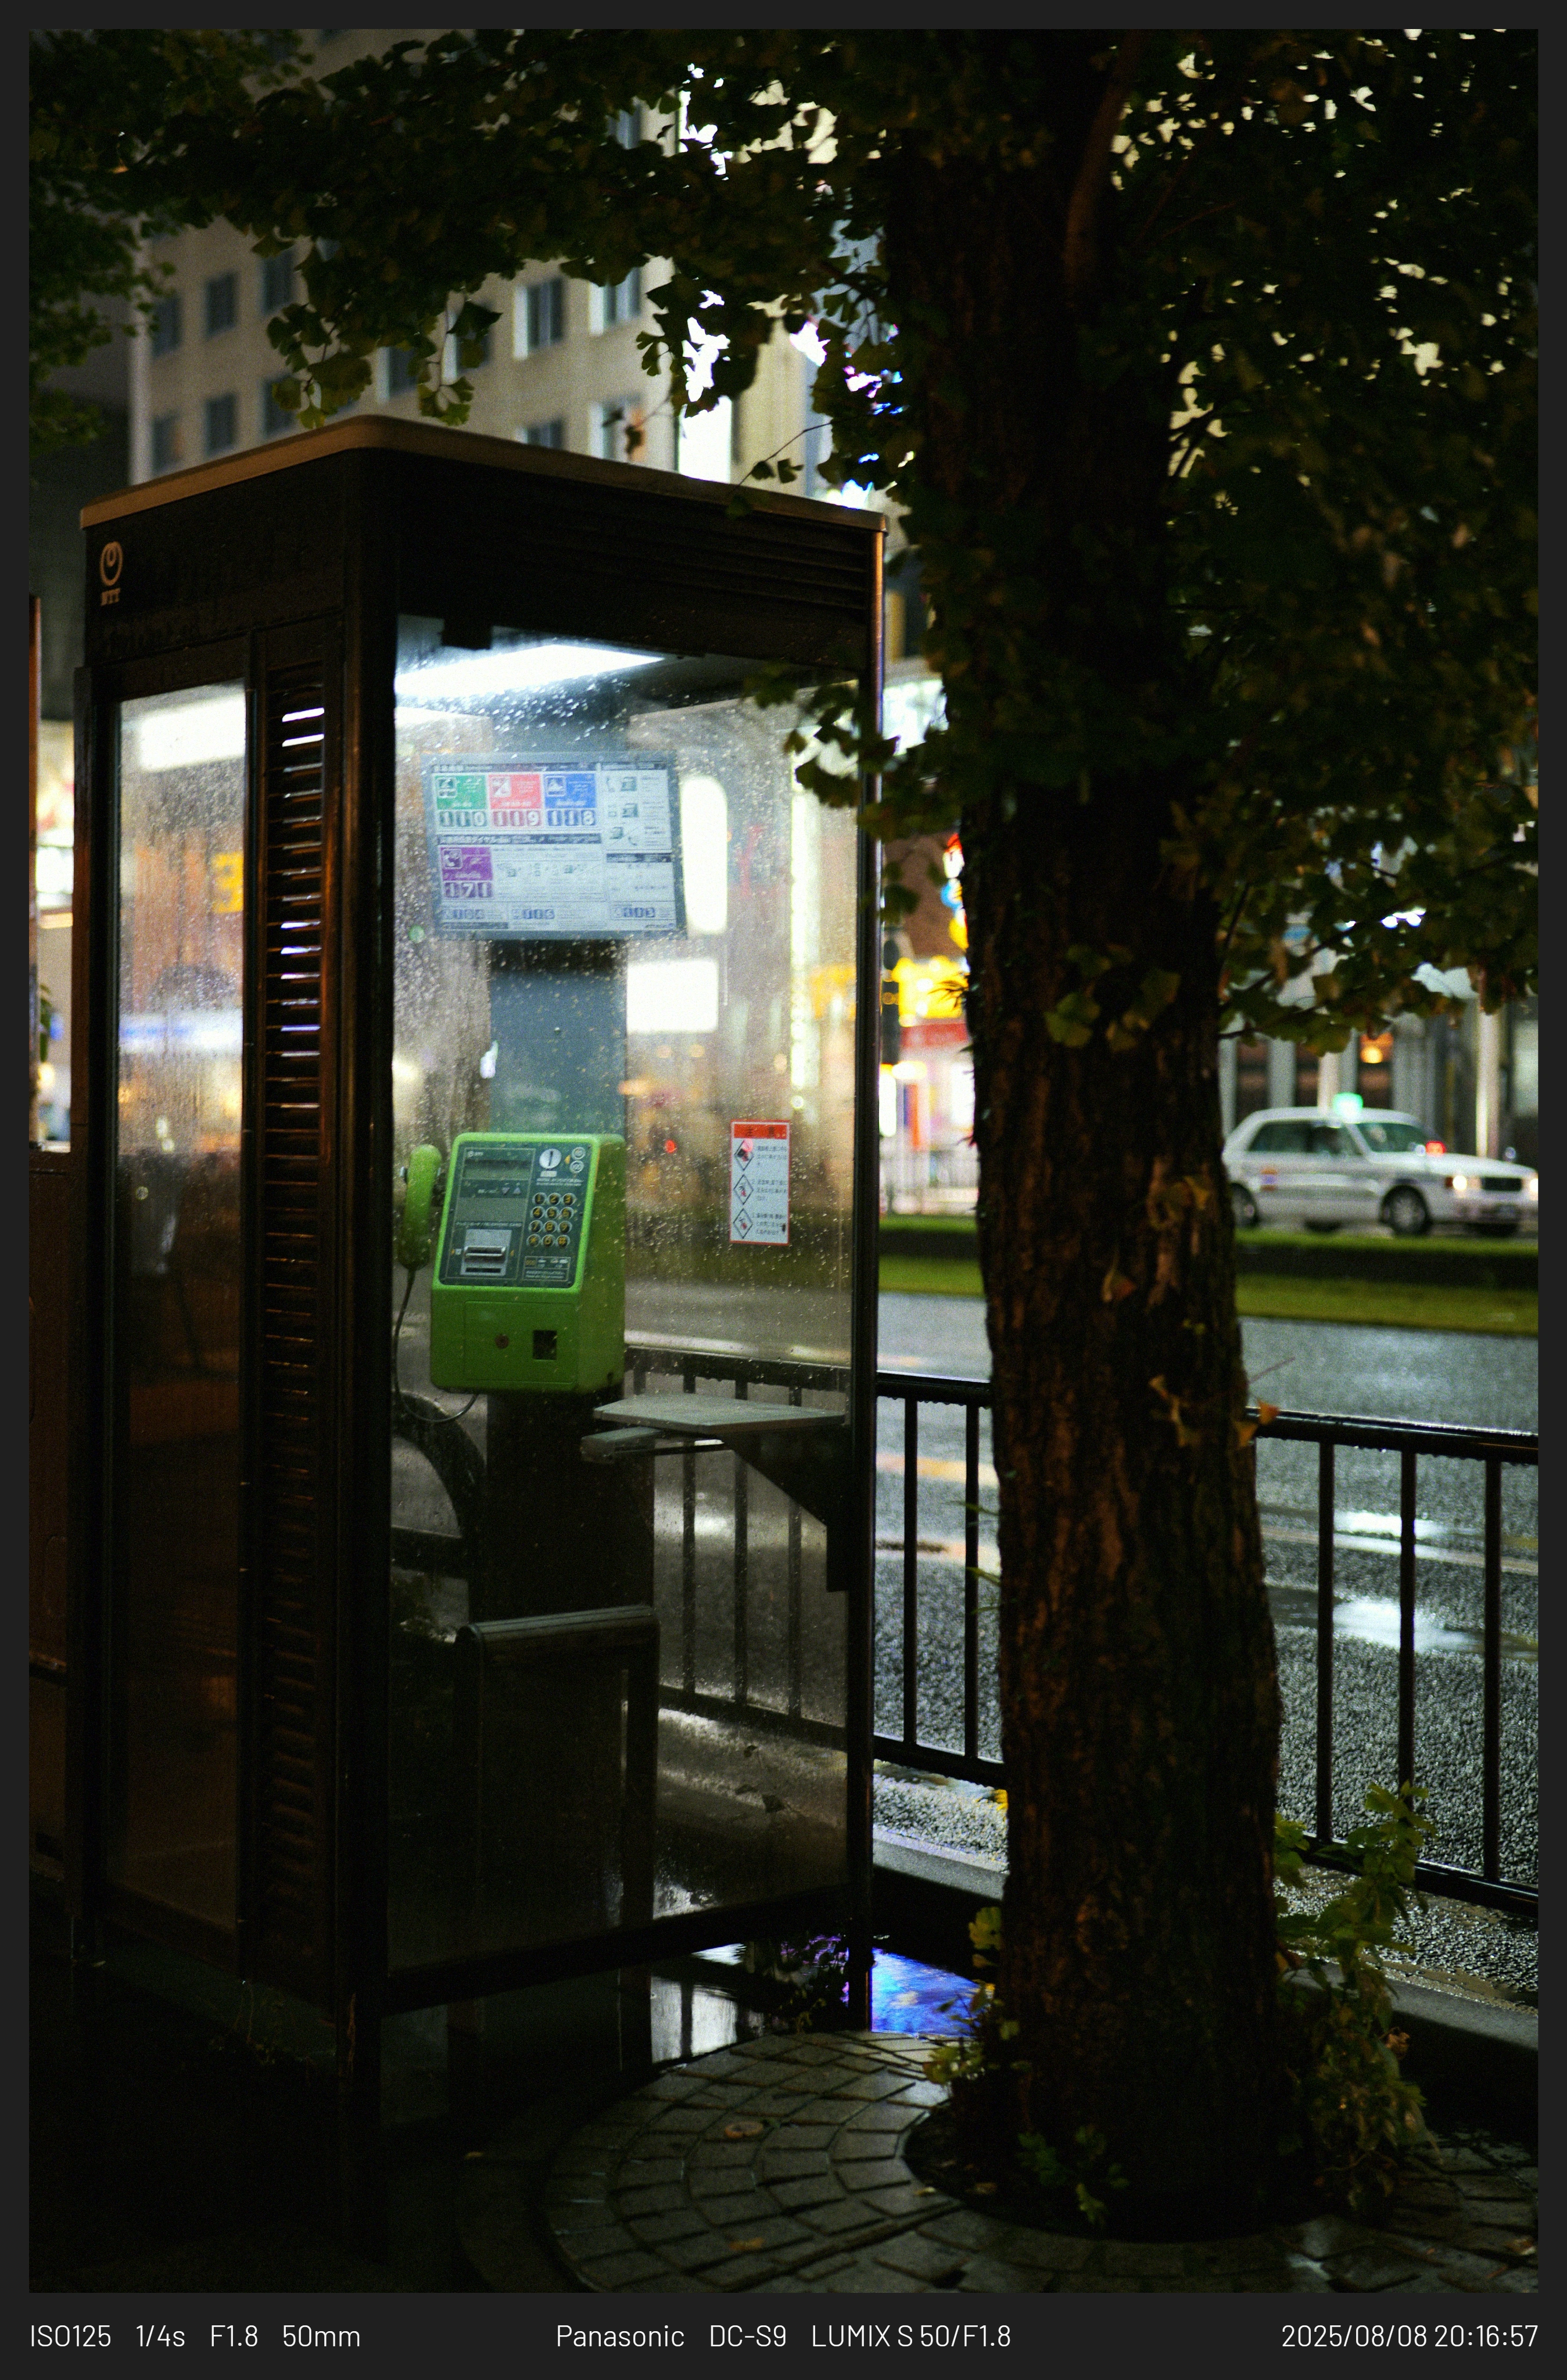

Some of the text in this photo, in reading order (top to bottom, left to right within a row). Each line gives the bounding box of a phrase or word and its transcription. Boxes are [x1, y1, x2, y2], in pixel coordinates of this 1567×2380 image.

[101, 587, 121, 606] NTT
[442, 811, 486, 826] 110
[496, 811, 541, 826] 119
[551, 810, 596, 826] 118
[446, 882, 492, 898] 171
